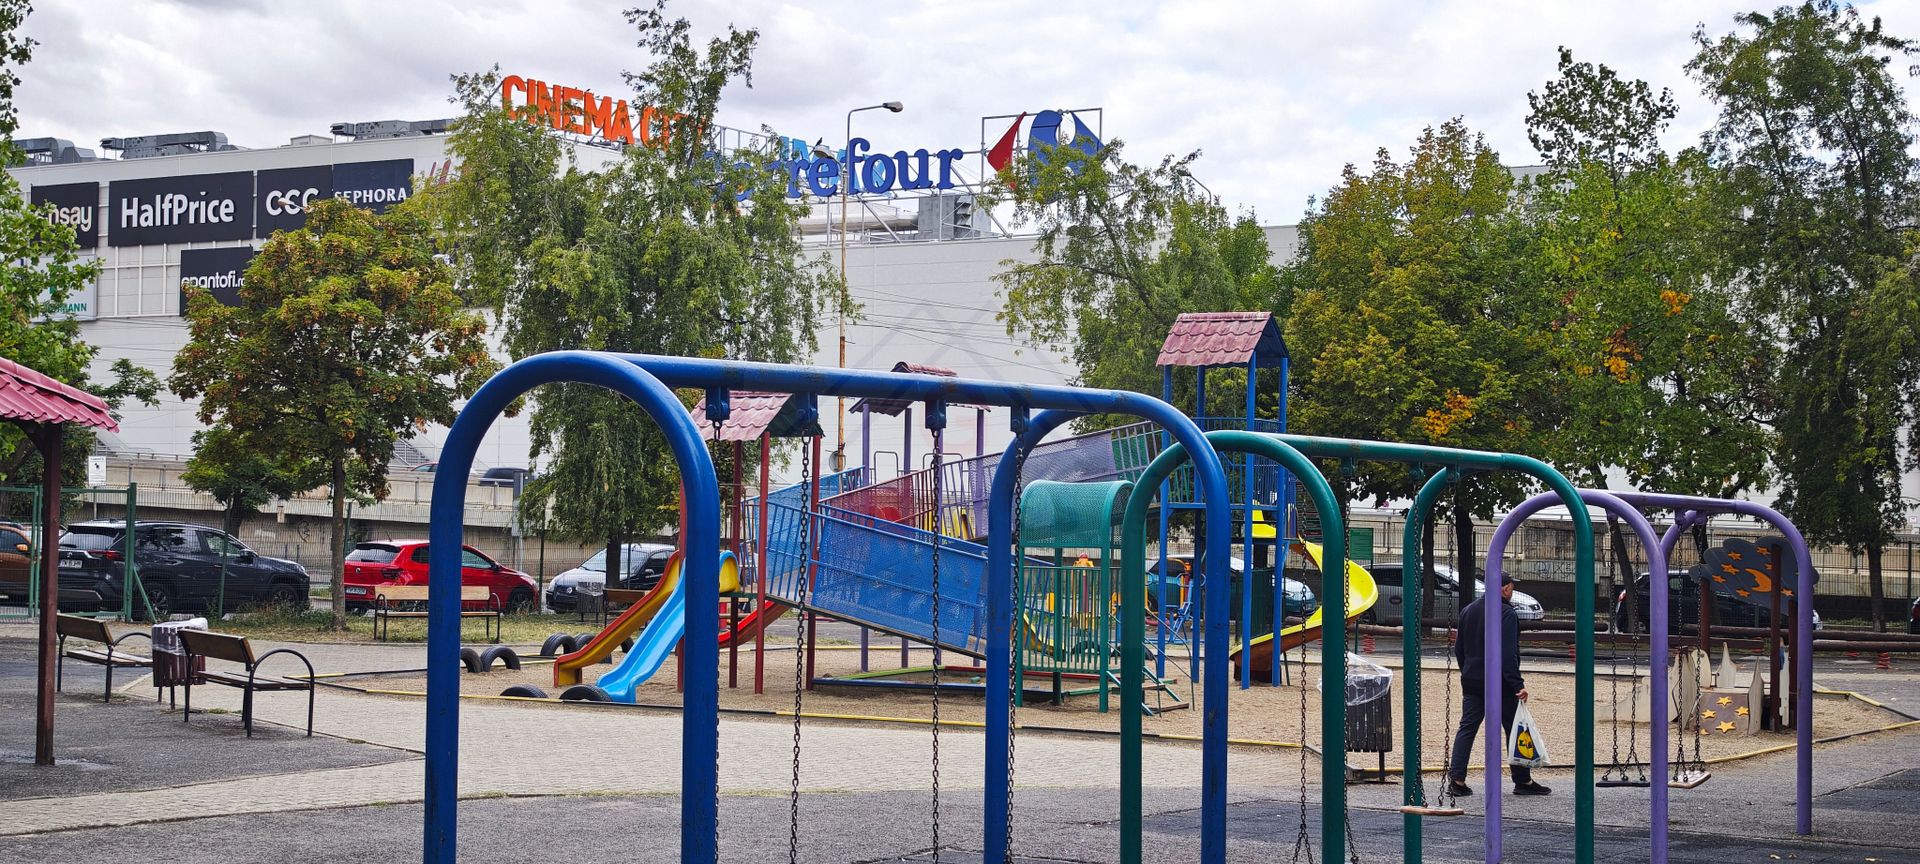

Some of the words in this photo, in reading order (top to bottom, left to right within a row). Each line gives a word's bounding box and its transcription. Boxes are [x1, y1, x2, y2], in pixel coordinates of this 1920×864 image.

[502, 75, 635, 145] CINEMA
[121, 191, 235, 228] HalfPrice
[334, 187, 407, 204] SEPHORA
